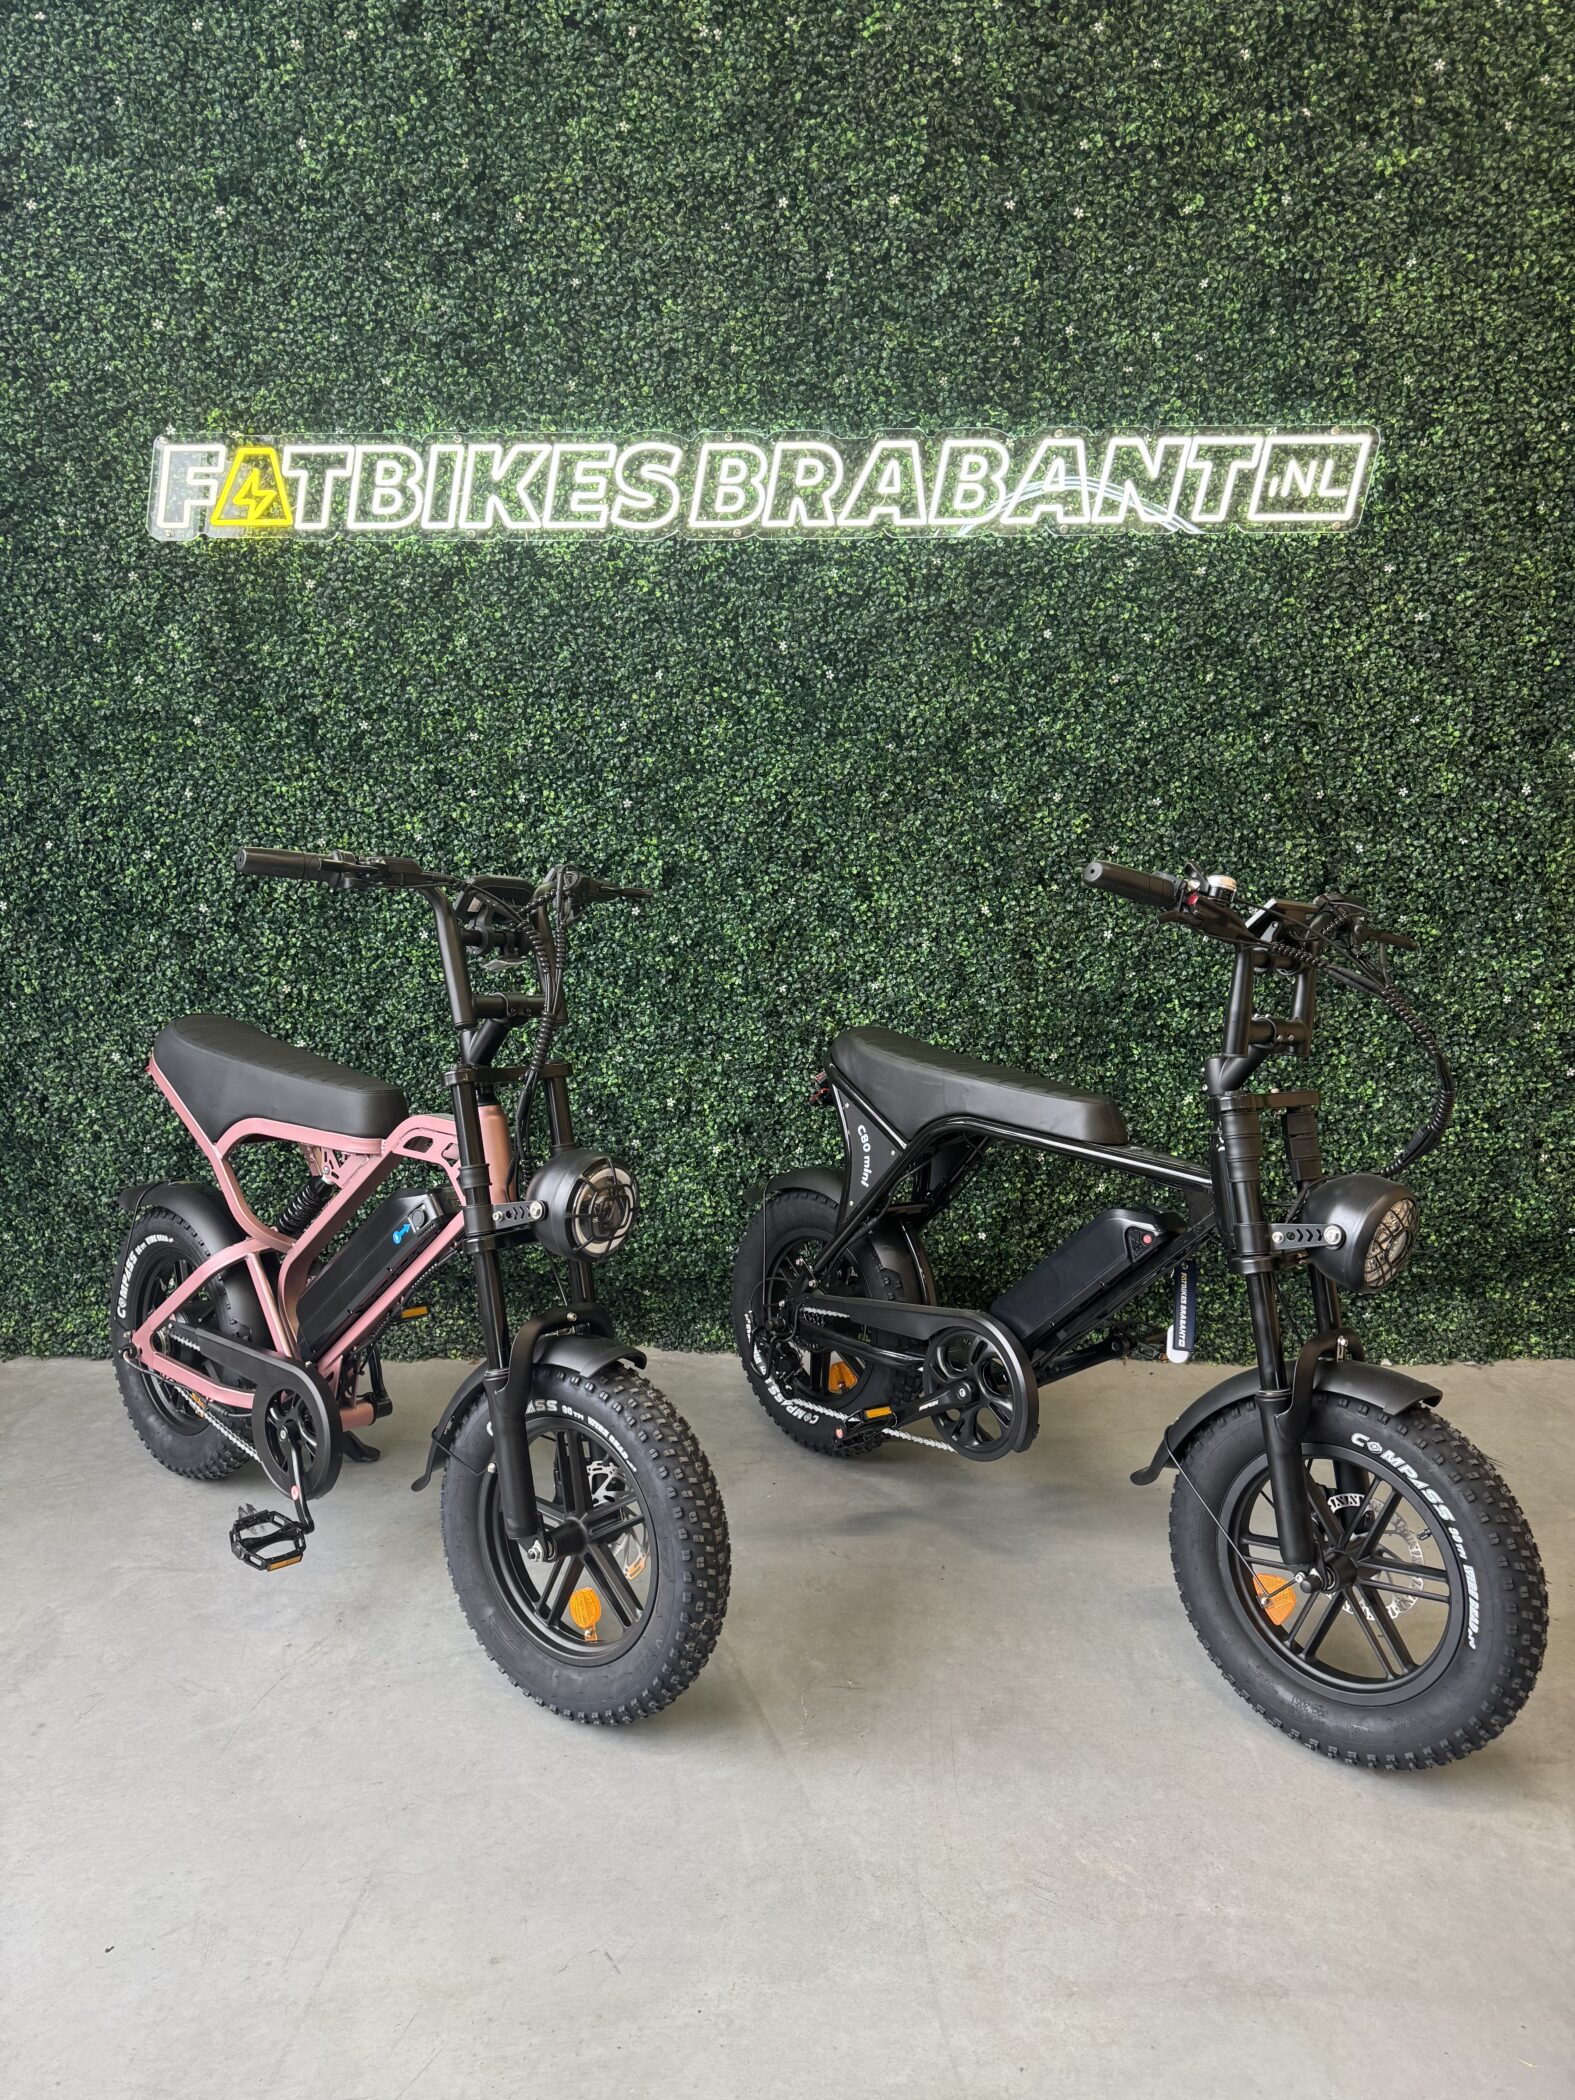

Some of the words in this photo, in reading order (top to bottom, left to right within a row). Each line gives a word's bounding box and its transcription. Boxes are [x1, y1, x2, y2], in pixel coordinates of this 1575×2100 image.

[155, 442, 684, 529] FATBIKES
[687, 436, 1263, 527] BRABANT
[857, 1124, 871, 1152] C80
[860, 1155, 872, 1188] mini
[117, 1250, 138, 1319] COMPASS
[1179, 1304, 1187, 1340] BRABANT
[1351, 1432, 1456, 1522] COMPASS
